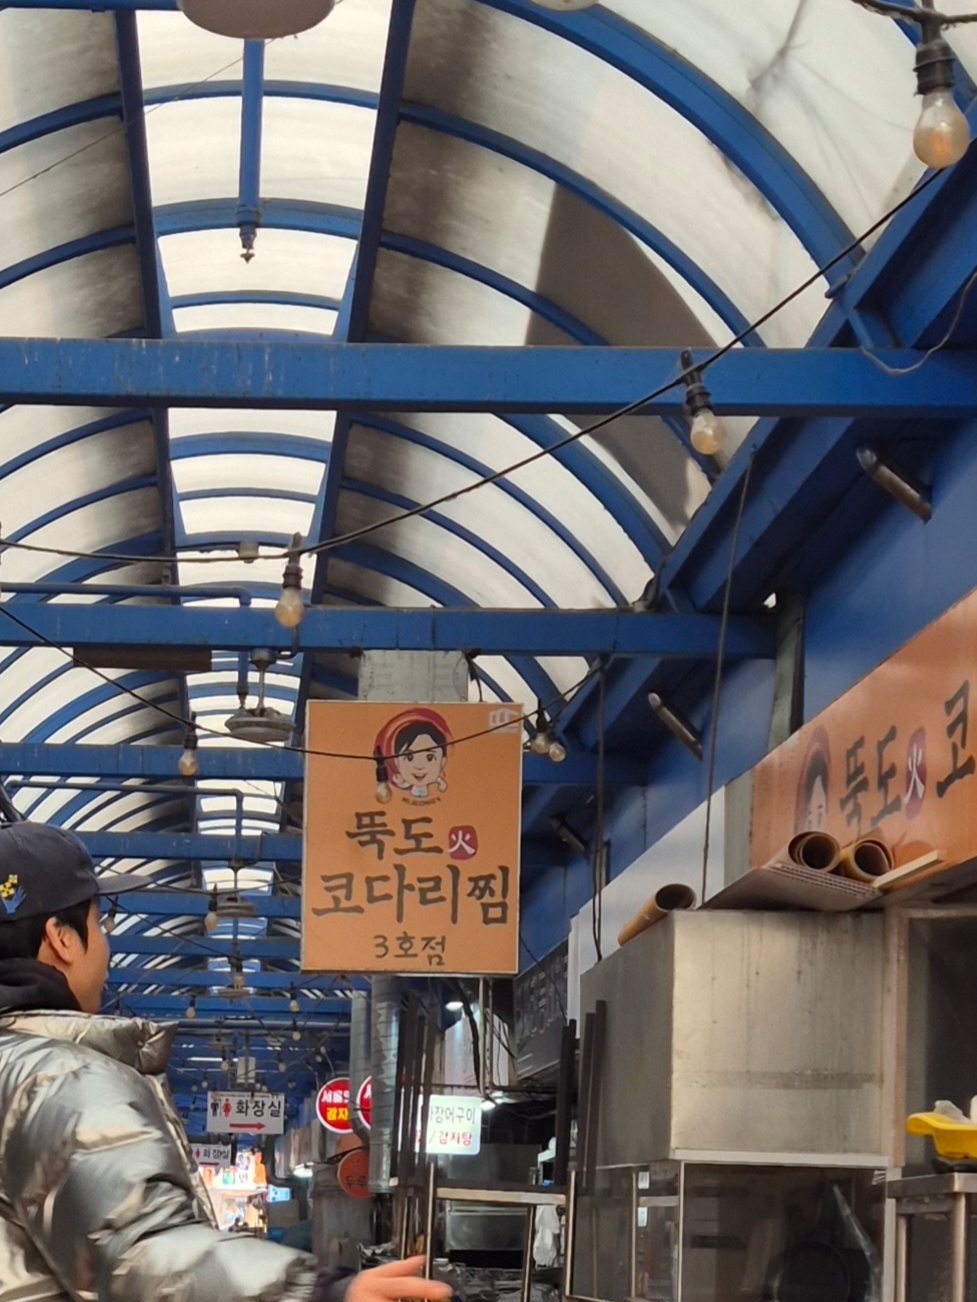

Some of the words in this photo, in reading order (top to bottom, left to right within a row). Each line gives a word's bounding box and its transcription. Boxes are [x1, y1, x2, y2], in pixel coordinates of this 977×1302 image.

[345, 810, 444, 860] 뚝도
[312, 864, 510, 926] 코다리찜
[373, 932, 446, 966] 3호점
[236, 1099, 281, 1118] 화장실
